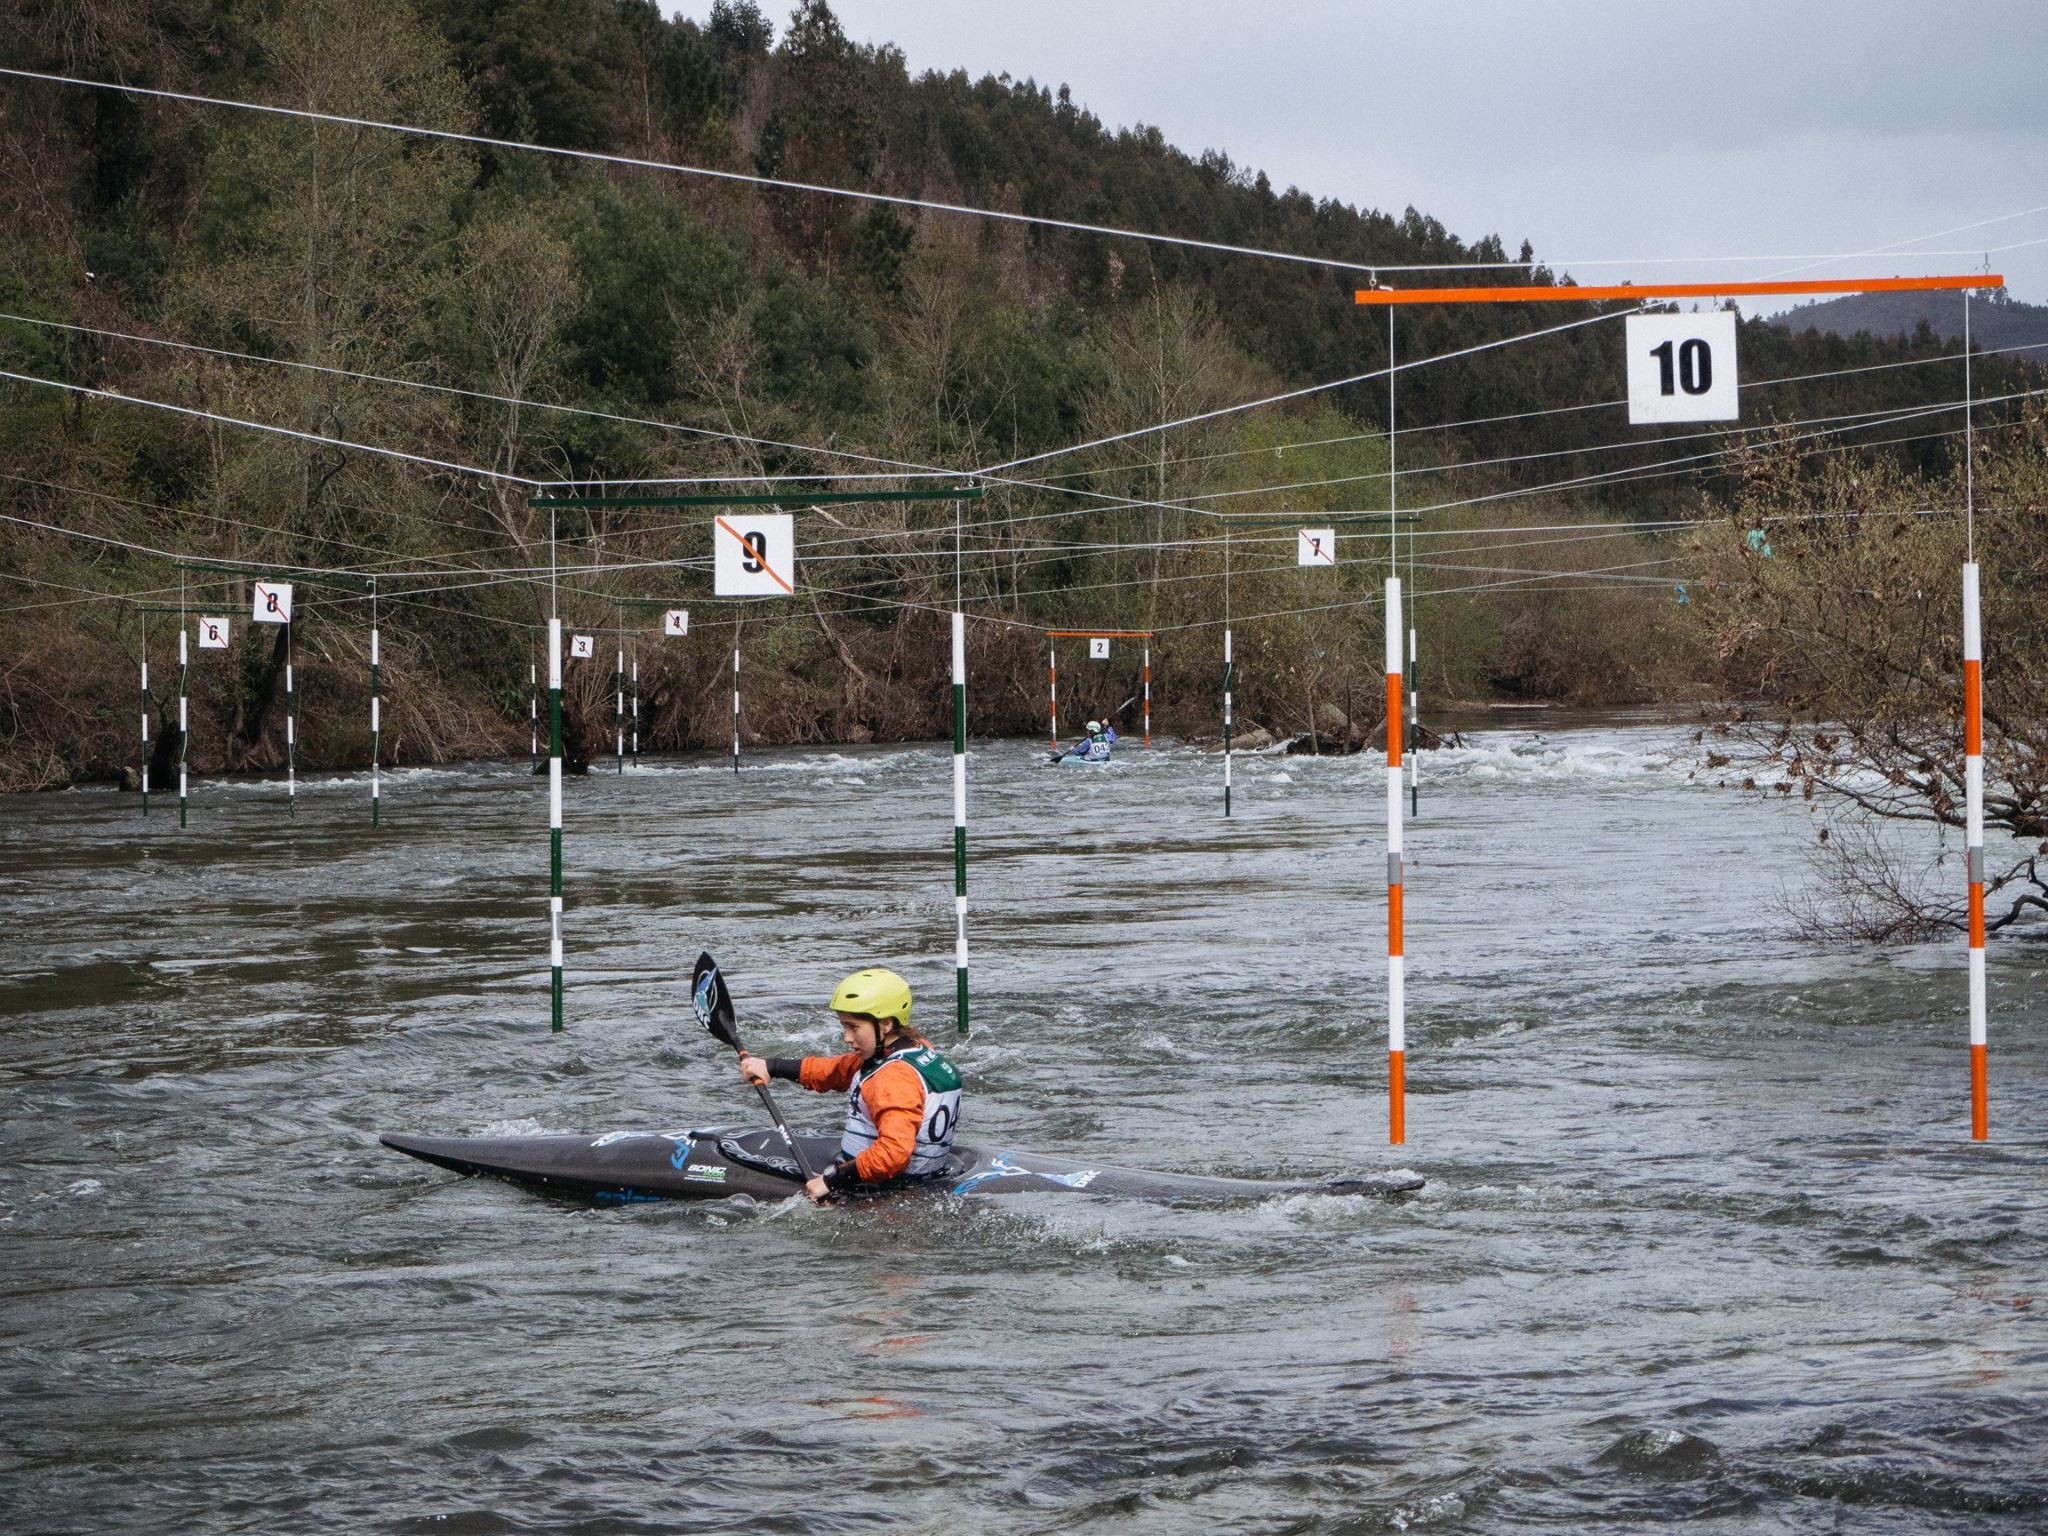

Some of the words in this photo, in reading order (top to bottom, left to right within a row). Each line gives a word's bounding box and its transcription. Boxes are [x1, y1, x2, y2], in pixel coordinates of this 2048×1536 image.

[1649, 338, 1713, 396] 10
[742, 531, 766, 574] 9
[1311, 537, 1321, 557] 7
[266, 592, 279, 613] 8
[673, 616, 681, 629] 4
[208, 624, 219, 641] 6
[579, 641, 586, 653] 3
[1096, 642, 1103, 653] 2
